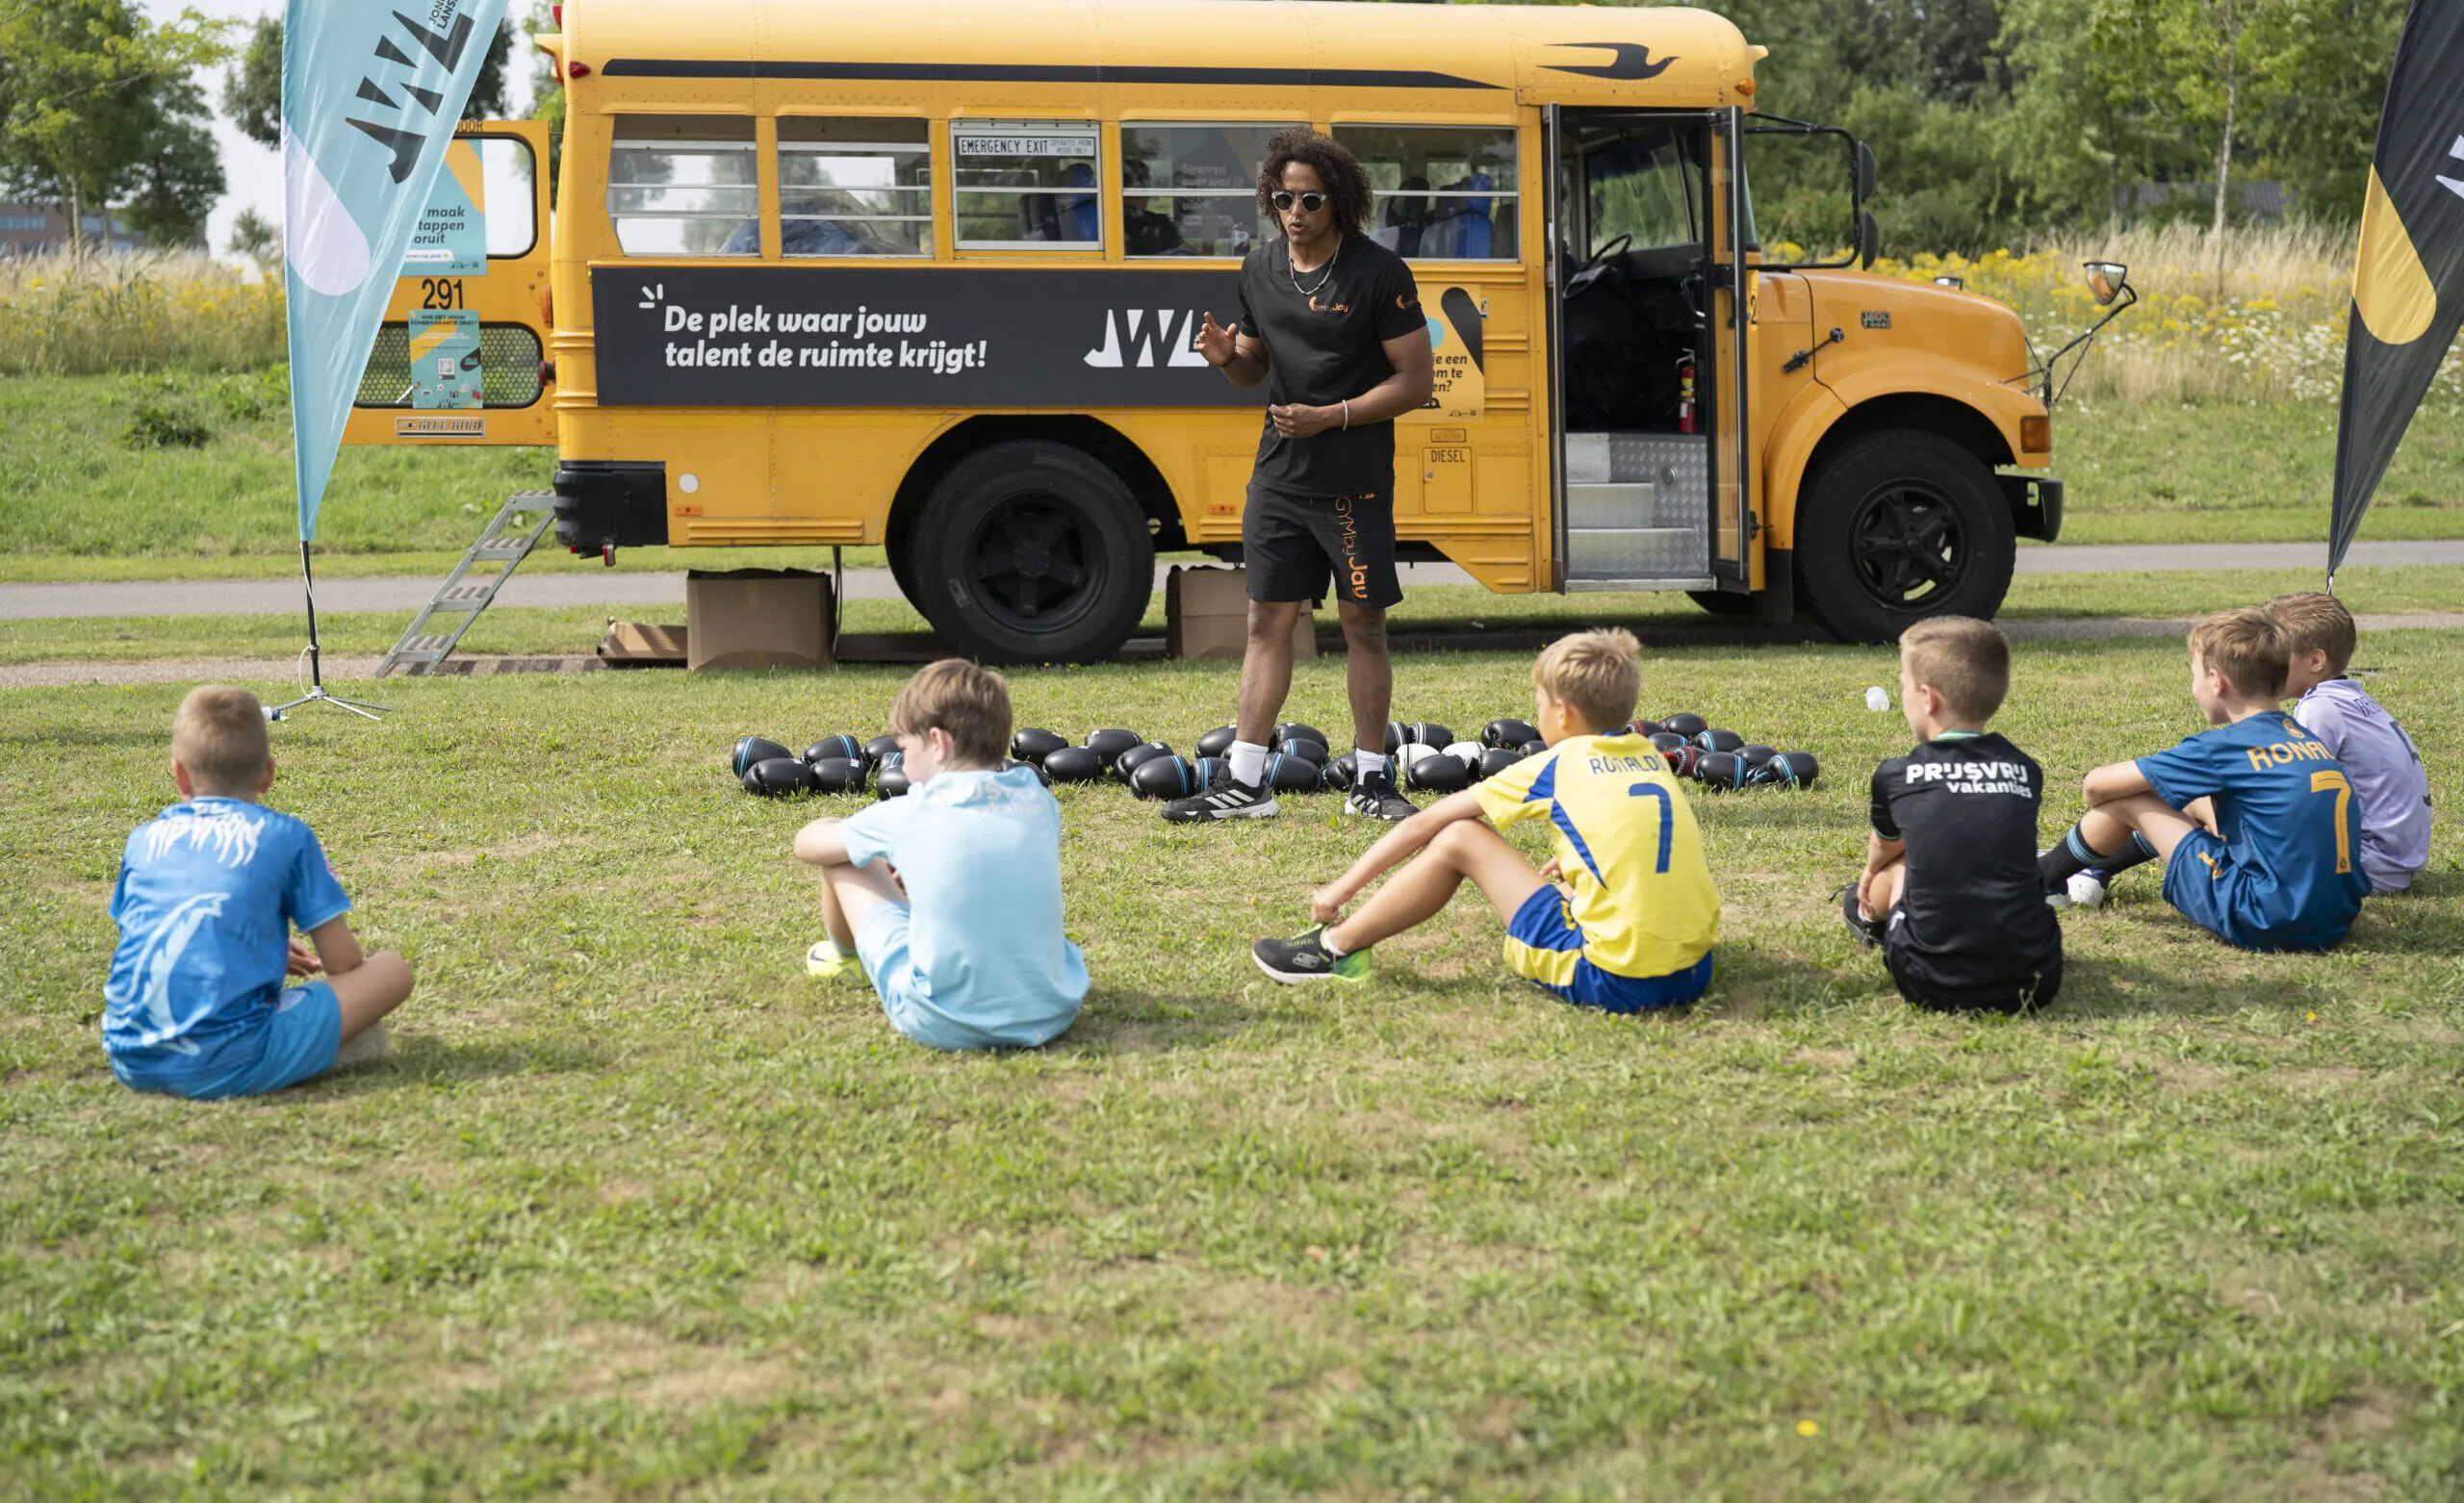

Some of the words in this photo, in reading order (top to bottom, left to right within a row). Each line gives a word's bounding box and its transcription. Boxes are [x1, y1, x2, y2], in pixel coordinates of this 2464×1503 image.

[429, 0, 445, 25] JON
[437, 0, 458, 29] LANS
[961, 140, 1021, 154] EMERGENCY
[1026, 140, 1049, 154] EXIT
[427, 206, 465, 217] maak
[418, 219, 465, 233] tappen
[414, 232, 446, 243] oruit
[422, 278, 464, 310] 291
[664, 305, 704, 332] De
[708, 304, 772, 339] plek
[777, 313, 853, 333] waar
[853, 305, 927, 340] jouw
[665, 339, 752, 367] talent
[757, 339, 794, 367] de
[799, 340, 893, 368] ruimte
[899, 340, 988, 374] krijgt!
[1445, 355, 1468, 365] een
[1450, 368, 1463, 378] te
[1431, 380, 1452, 393] en?
[1430, 449, 1466, 463] DIESEL
[2246, 741, 2336, 772] RONAL
[1946, 779, 2033, 799] vakanties
[1629, 782, 1673, 875] 7
[2310, 770, 2351, 875] 7
